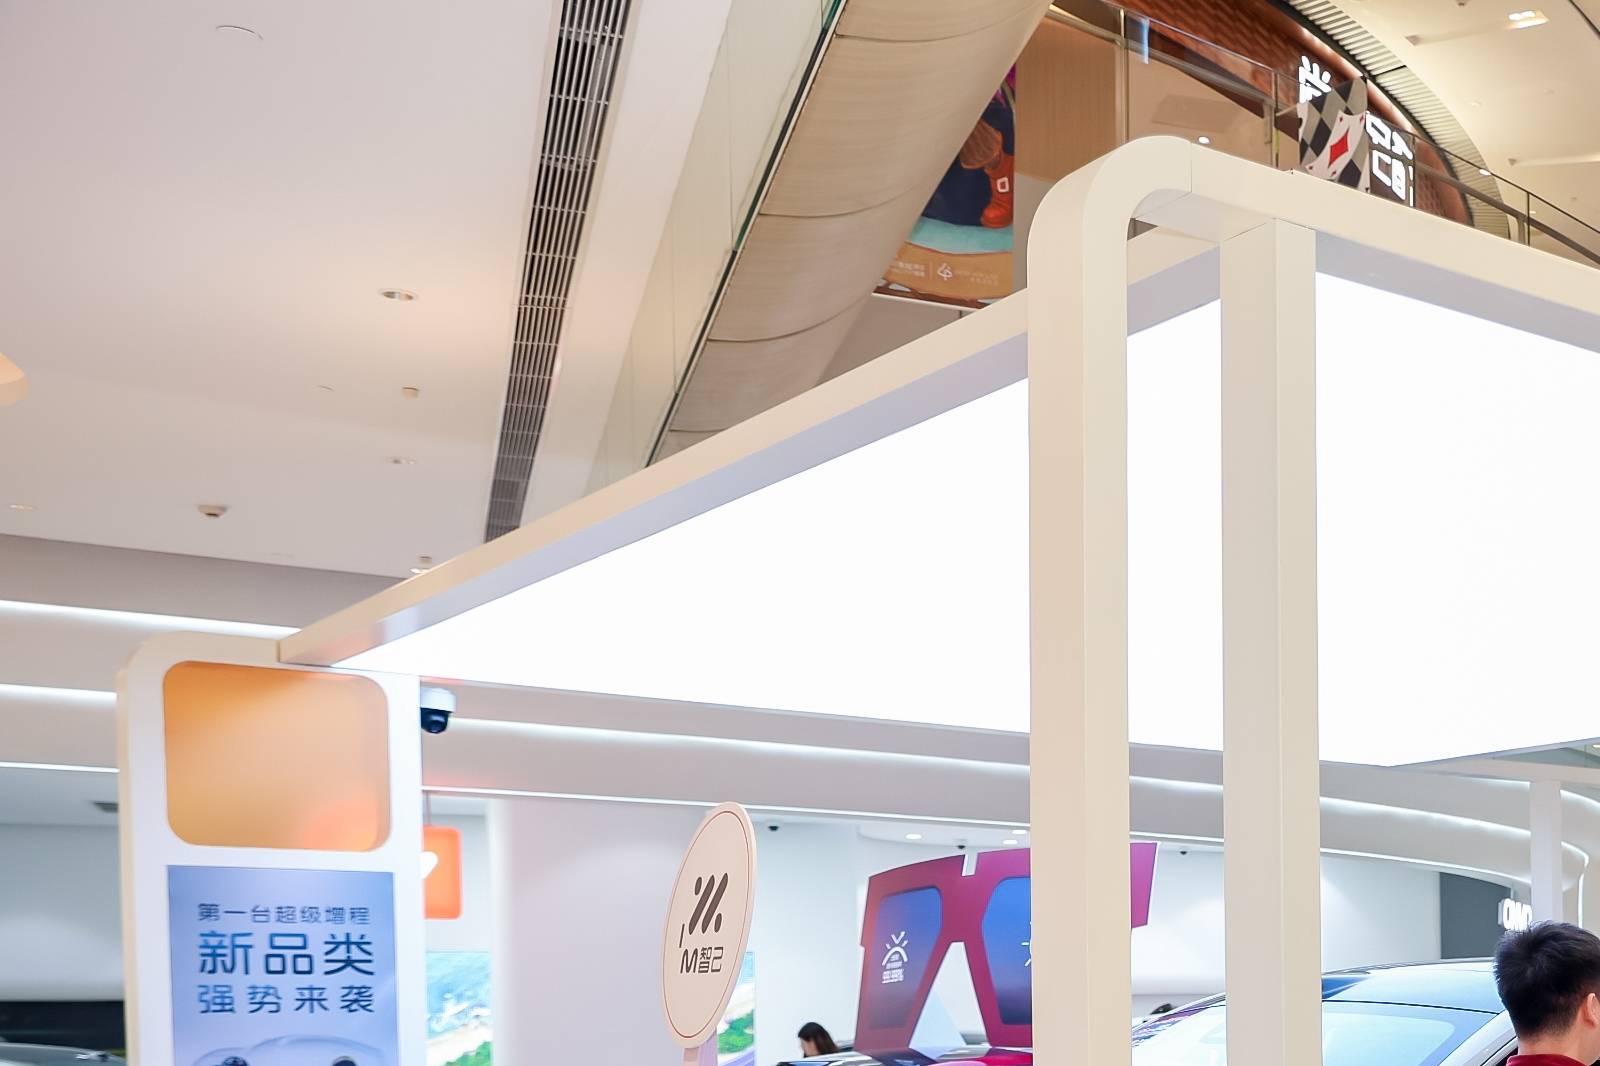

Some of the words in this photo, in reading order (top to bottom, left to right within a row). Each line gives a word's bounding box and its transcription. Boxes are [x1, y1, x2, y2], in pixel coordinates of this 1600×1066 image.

[198, 904, 370, 925] 第一台超级增程
[198, 930, 376, 976] 新品类
[197, 984, 376, 1014] 强势来袭
